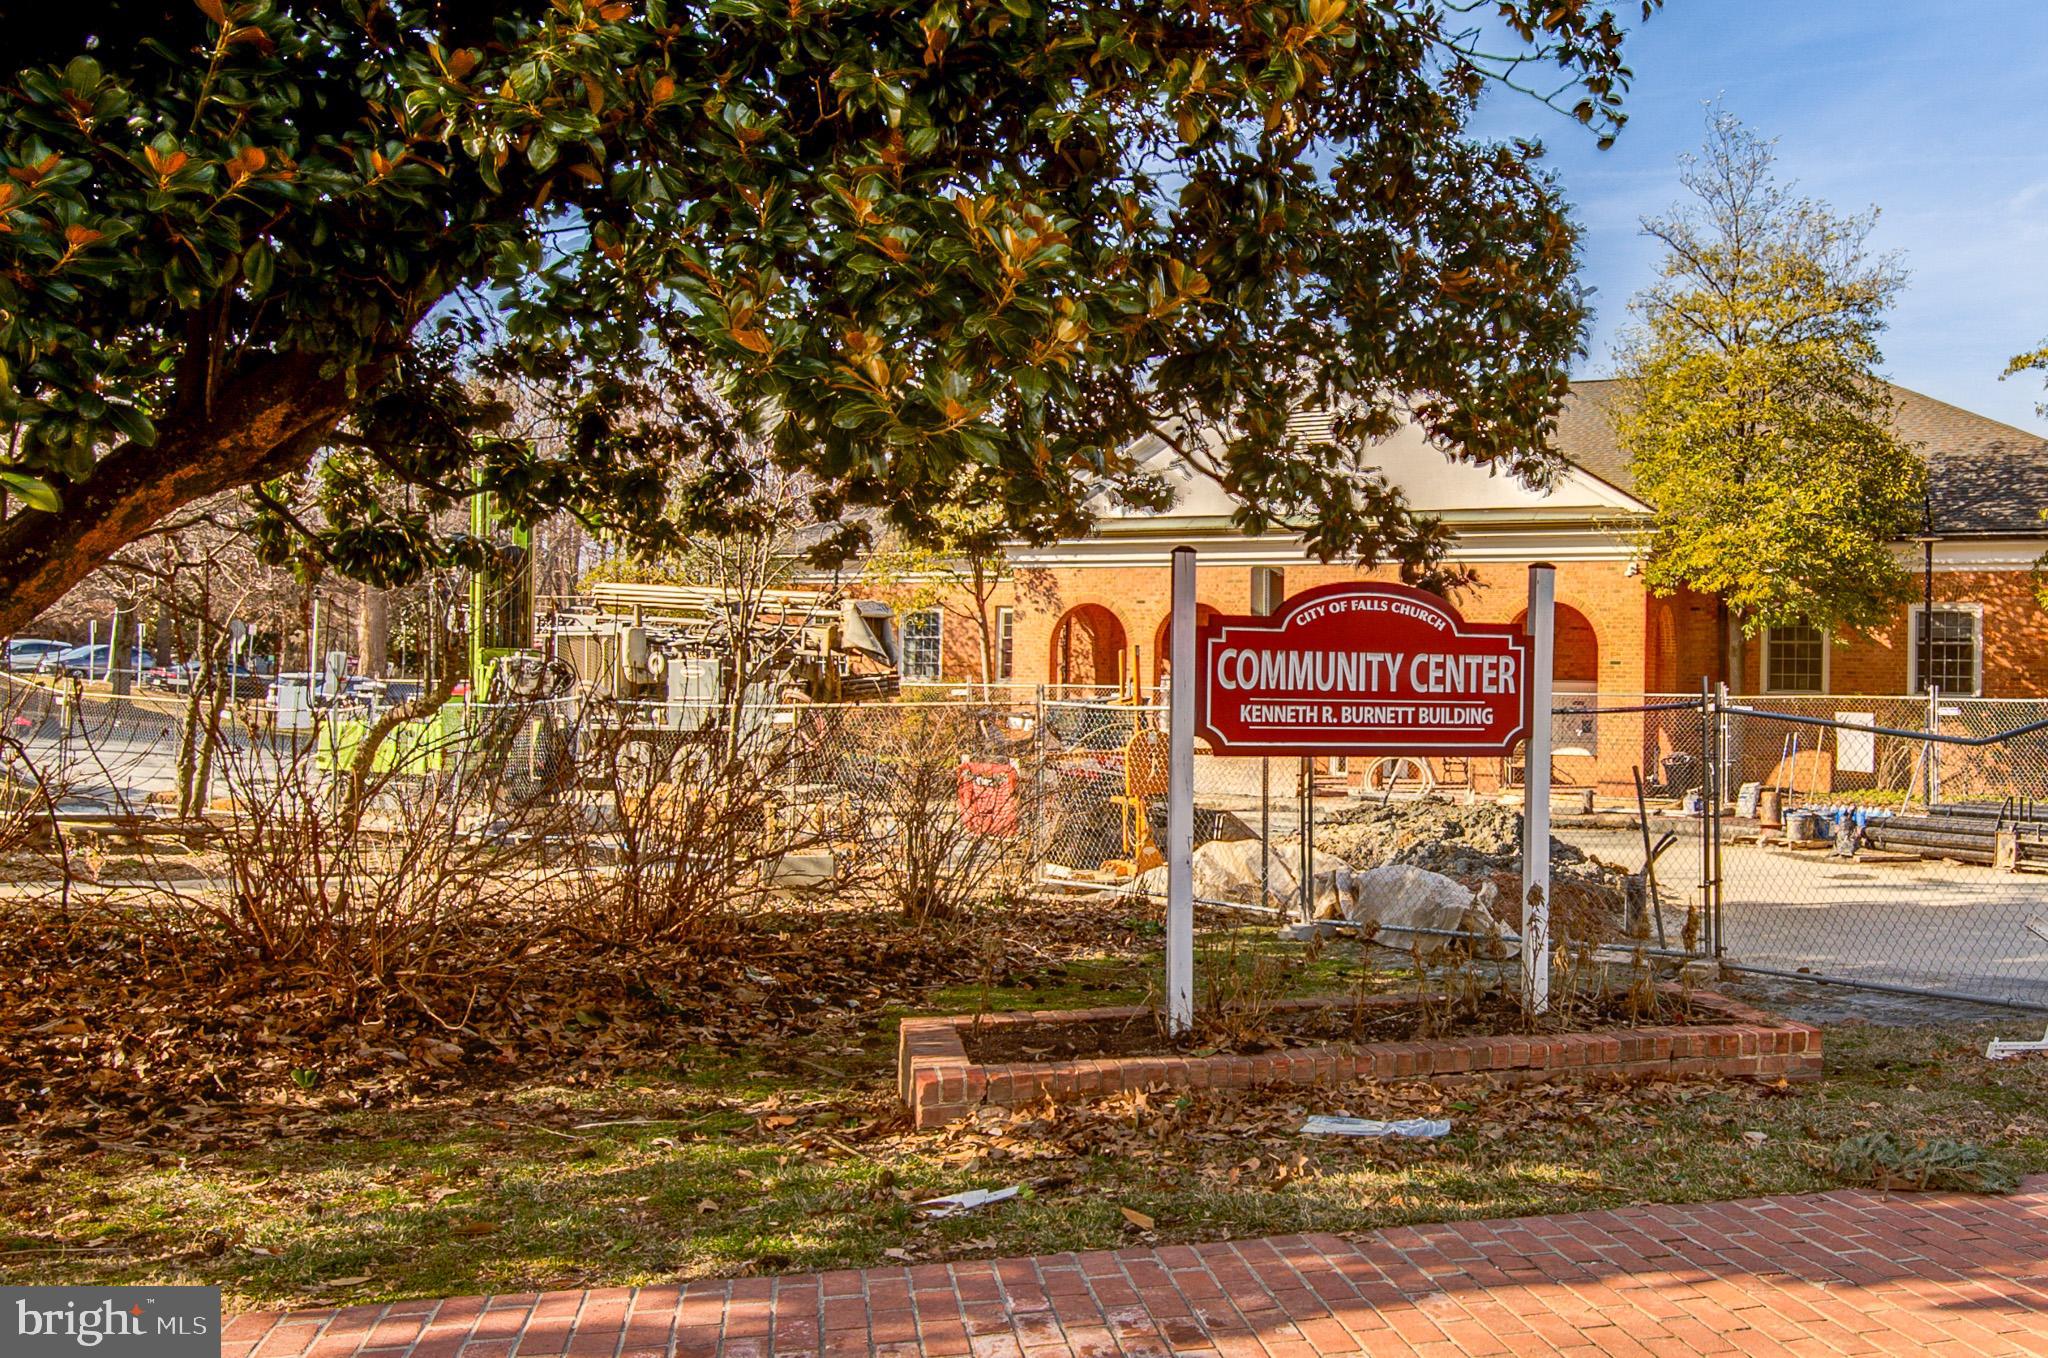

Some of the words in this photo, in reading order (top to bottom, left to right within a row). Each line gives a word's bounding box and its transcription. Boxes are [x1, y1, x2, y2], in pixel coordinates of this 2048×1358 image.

[1296, 604, 1326, 626] CITY
[1328, 600, 1348, 614] OF
[1351, 599, 1388, 612] FALLS
[1391, 601, 1446, 631] CHURCH
[1217, 648, 1404, 692] COMMUNITY
[1410, 653, 1516, 694] CENTER
[1240, 704, 1318, 724] KENNETH
[1321, 705, 1338, 724] R.
[1341, 705, 1415, 724] BURNETT
[1418, 706, 1494, 725] BUILDING
